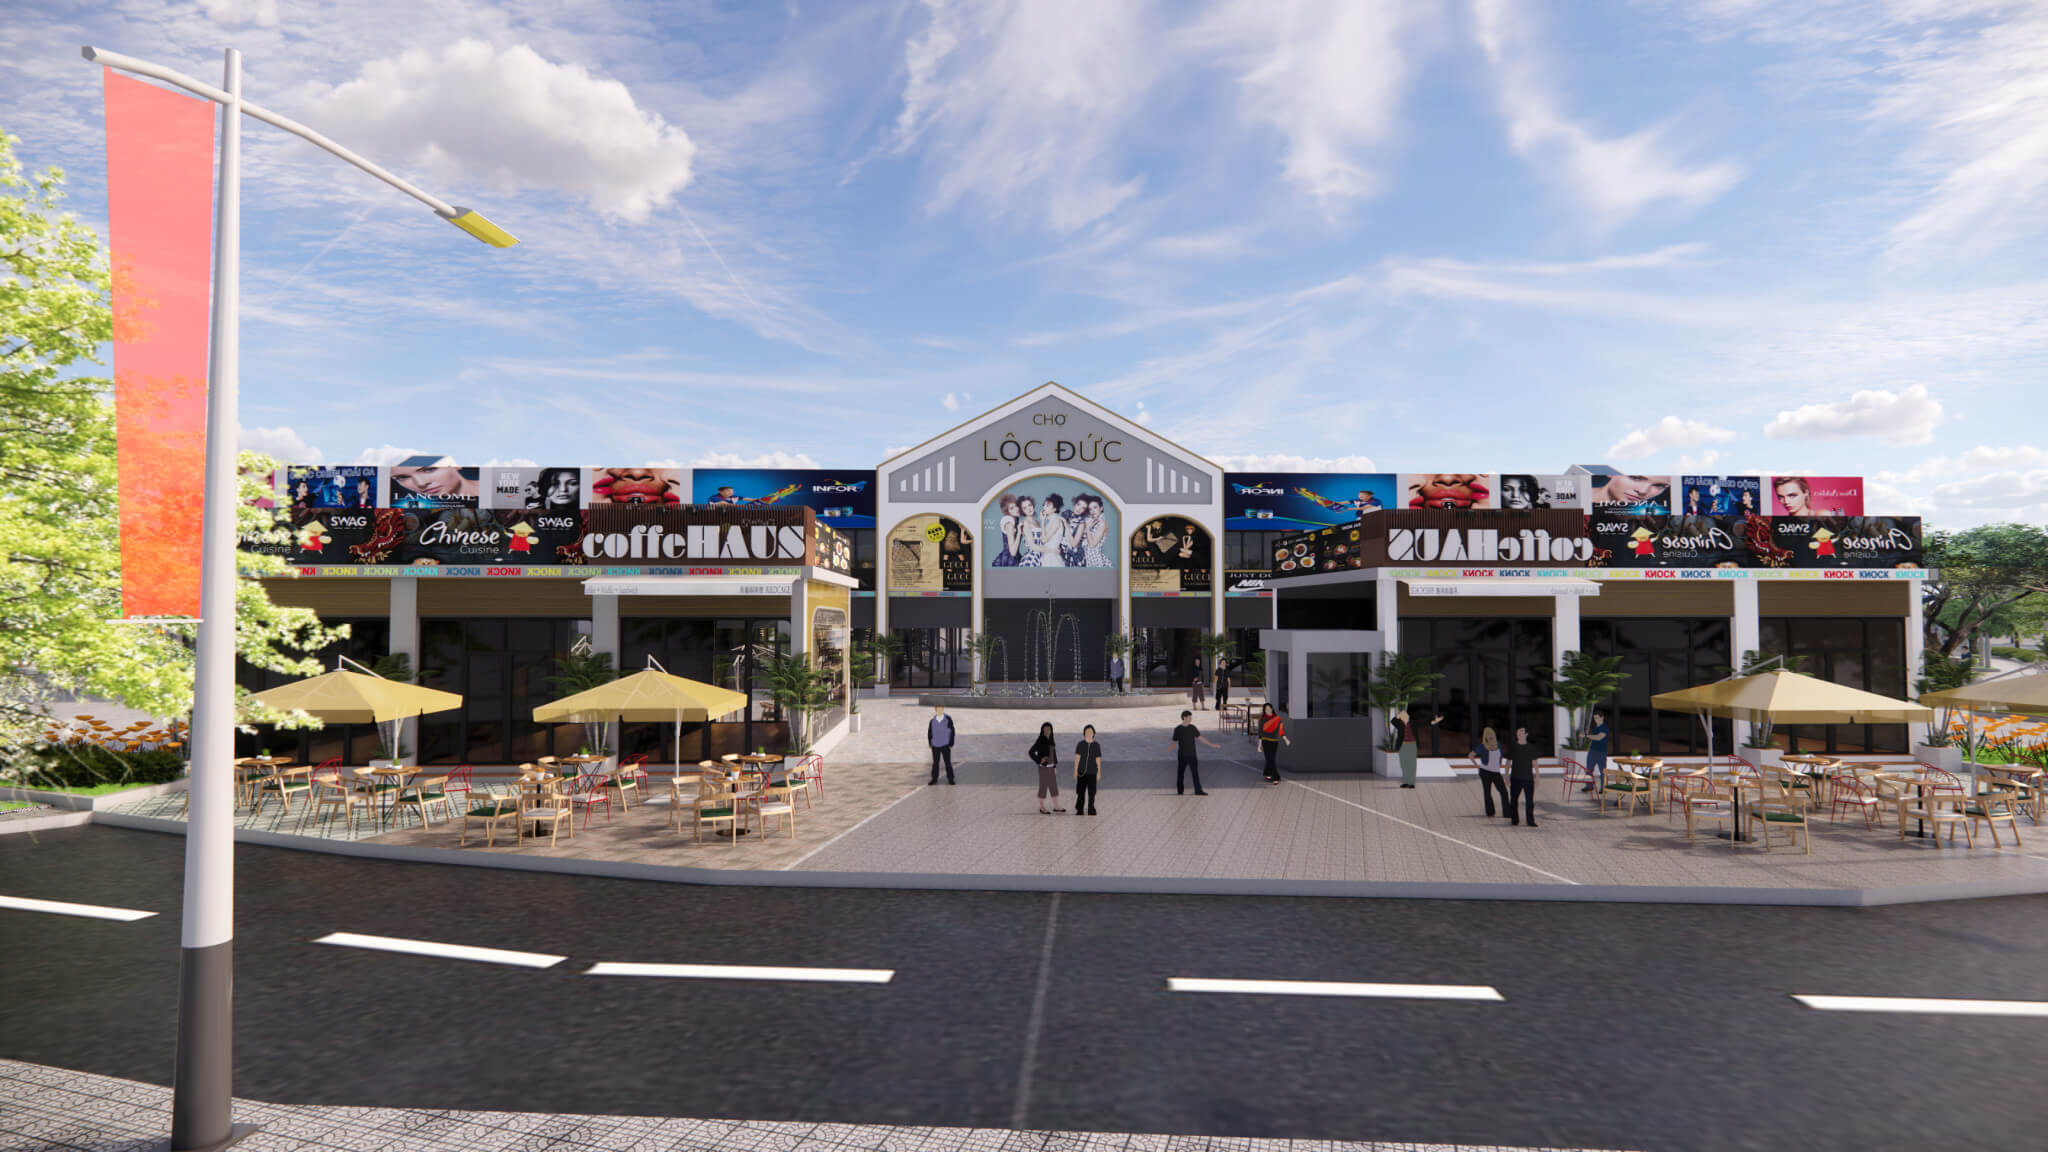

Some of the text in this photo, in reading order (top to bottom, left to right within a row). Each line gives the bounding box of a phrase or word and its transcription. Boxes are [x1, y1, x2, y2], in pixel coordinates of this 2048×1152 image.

[1032, 412, 1068, 428] CHỢ
[983, 432, 1123, 468] LỘC ĐỨC
[496, 486, 520, 494] MADE
[330, 515, 368, 527] SWAG
[538, 516, 574, 528] SWAG
[419, 520, 500, 546] Chinese
[582, 524, 806, 559] coffeHAUS
[250, 544, 292, 554] Cuisine
[459, 545, 500, 555] Cuisine
